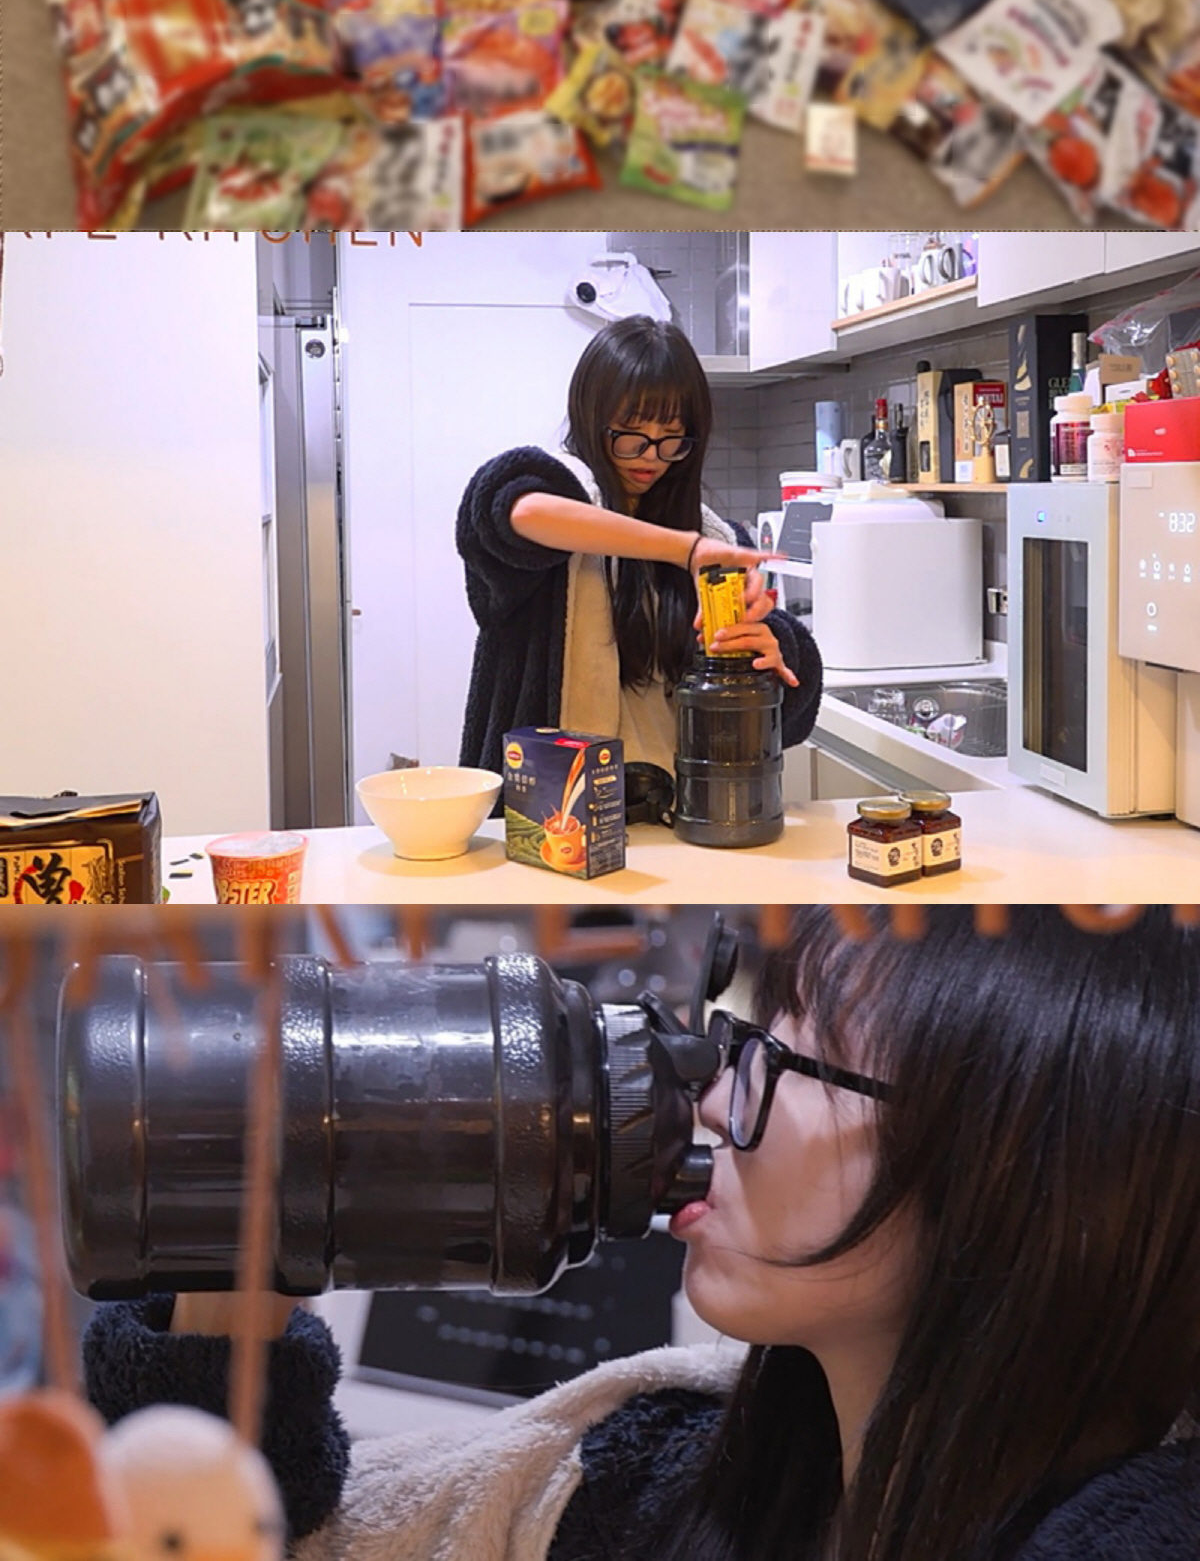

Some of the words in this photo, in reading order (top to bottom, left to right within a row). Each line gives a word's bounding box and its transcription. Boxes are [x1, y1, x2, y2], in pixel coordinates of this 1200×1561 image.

[1048, 377, 1070, 388] GLE
[1168, 512, 1196, 533] 832
[215, 878, 276, 904] BSTER
